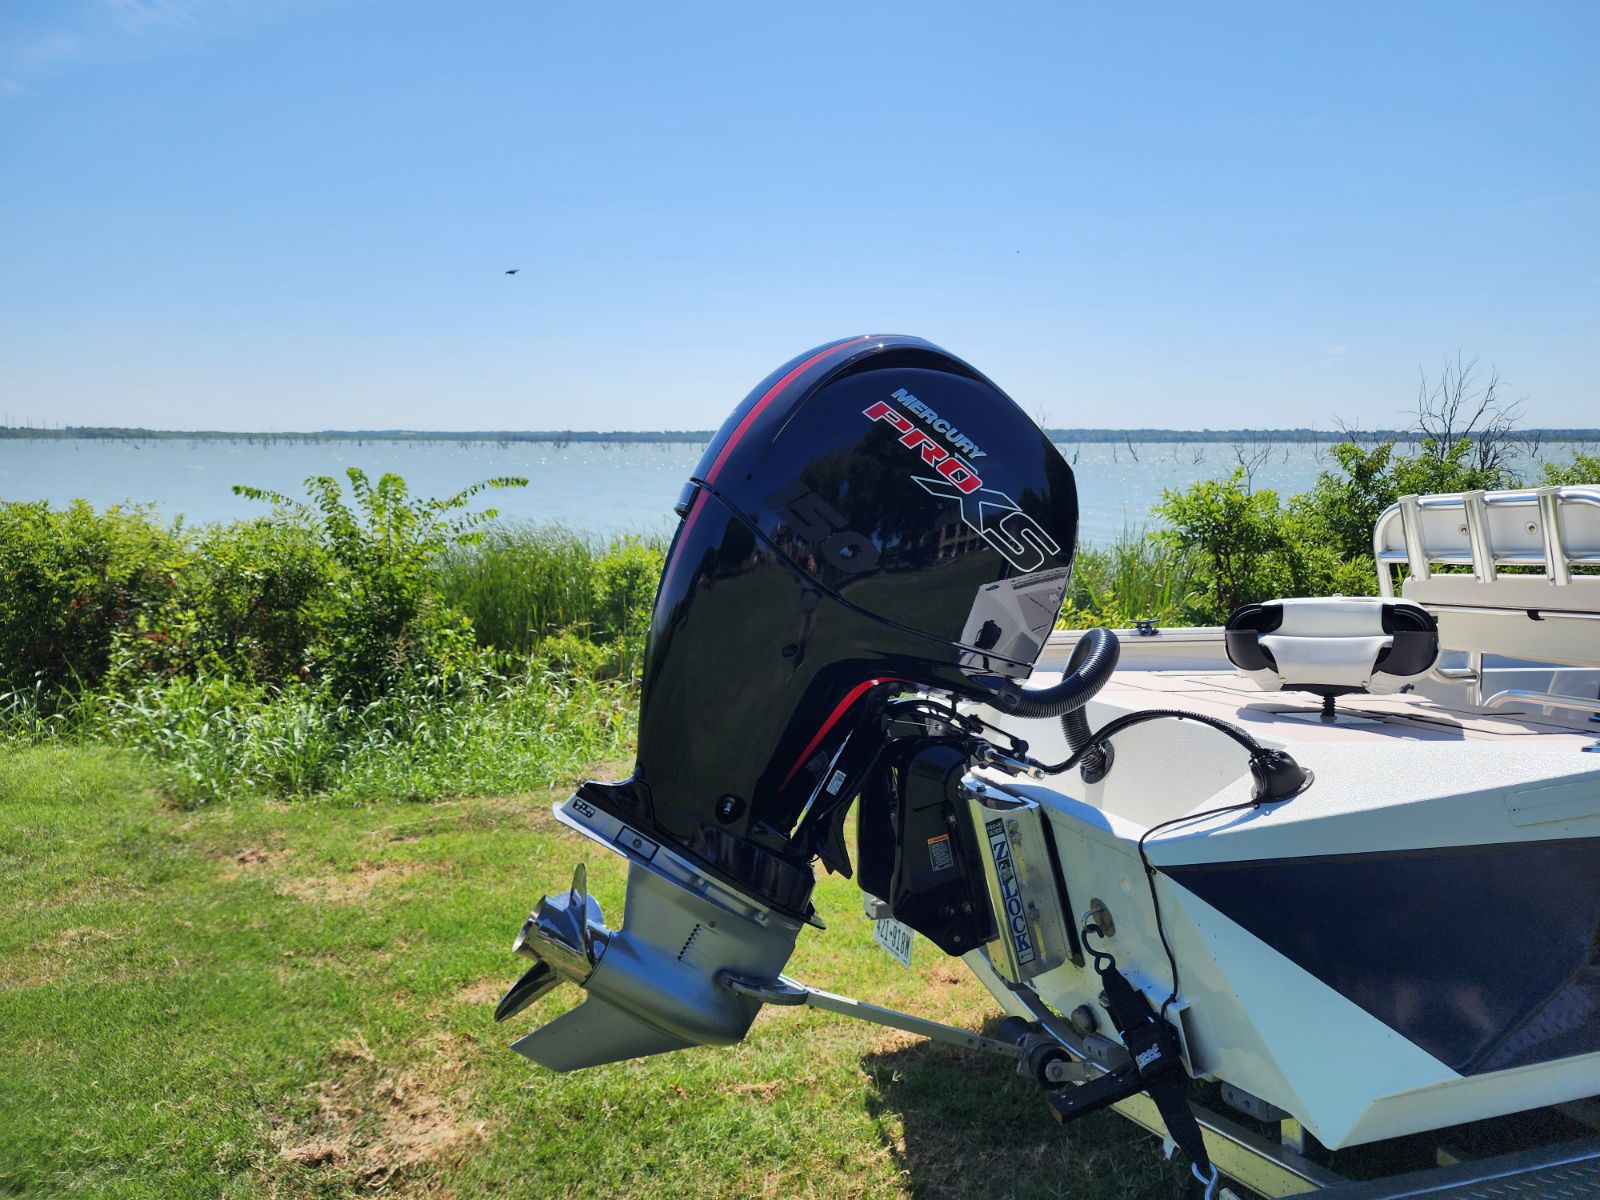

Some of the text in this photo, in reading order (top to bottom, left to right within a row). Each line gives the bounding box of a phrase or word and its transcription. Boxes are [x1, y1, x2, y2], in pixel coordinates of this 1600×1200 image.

[862, 401, 983, 494] PRO
[890, 388, 987, 460] MERCURY
[910, 452, 1061, 572] XS
